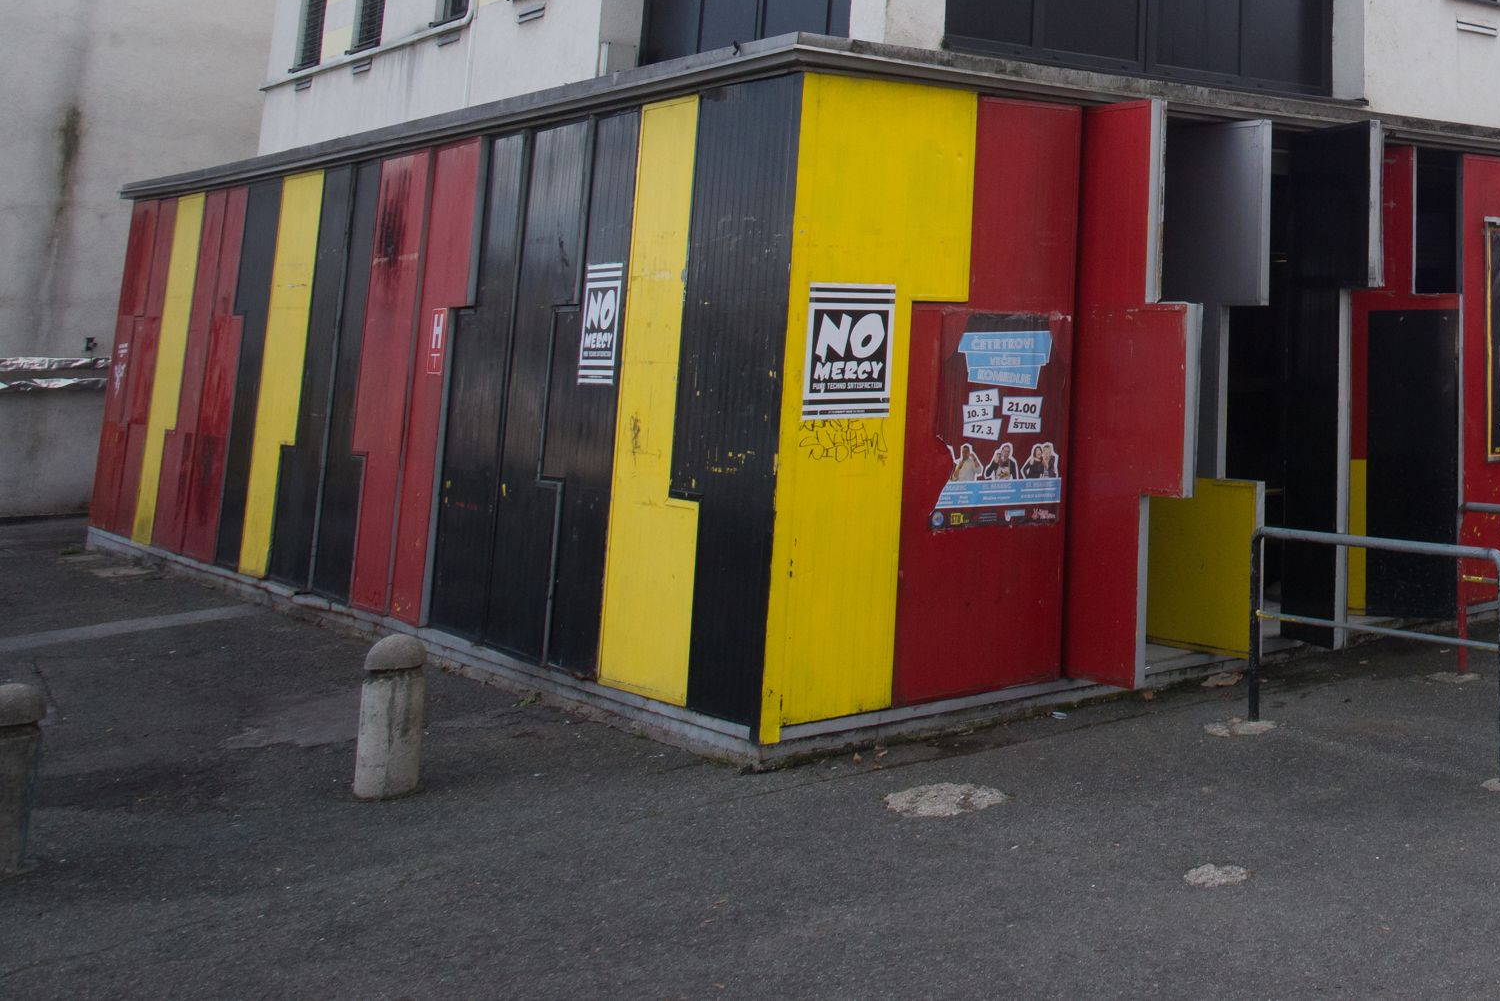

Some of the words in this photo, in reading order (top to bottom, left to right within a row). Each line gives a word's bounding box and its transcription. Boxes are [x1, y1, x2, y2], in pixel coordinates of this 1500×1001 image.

[586, 289, 615, 330] NO
[432, 314, 444, 349] H
[814, 312, 886, 359] NO
[583, 332, 613, 349] MERCY
[971, 335, 1035, 350] ČETRTKOVI
[990, 354, 1021, 366] VEČERI
[813, 361, 884, 380] MERCY
[977, 369, 1031, 385] KOMEDIJE
[827, 382, 846, 390] TECHNO
[847, 381, 883, 390] SATISFACTION
[975, 395, 983, 403] 3.
[985, 394, 993, 402] 3.
[967, 409, 979, 418] 10.
[981, 408, 989, 416] 3.
[1007, 401, 1037, 414] 21.00
[971, 424, 984, 434] 17.
[986, 426, 994, 435] 3.
[1013, 418, 1037, 430] ŠTUK
